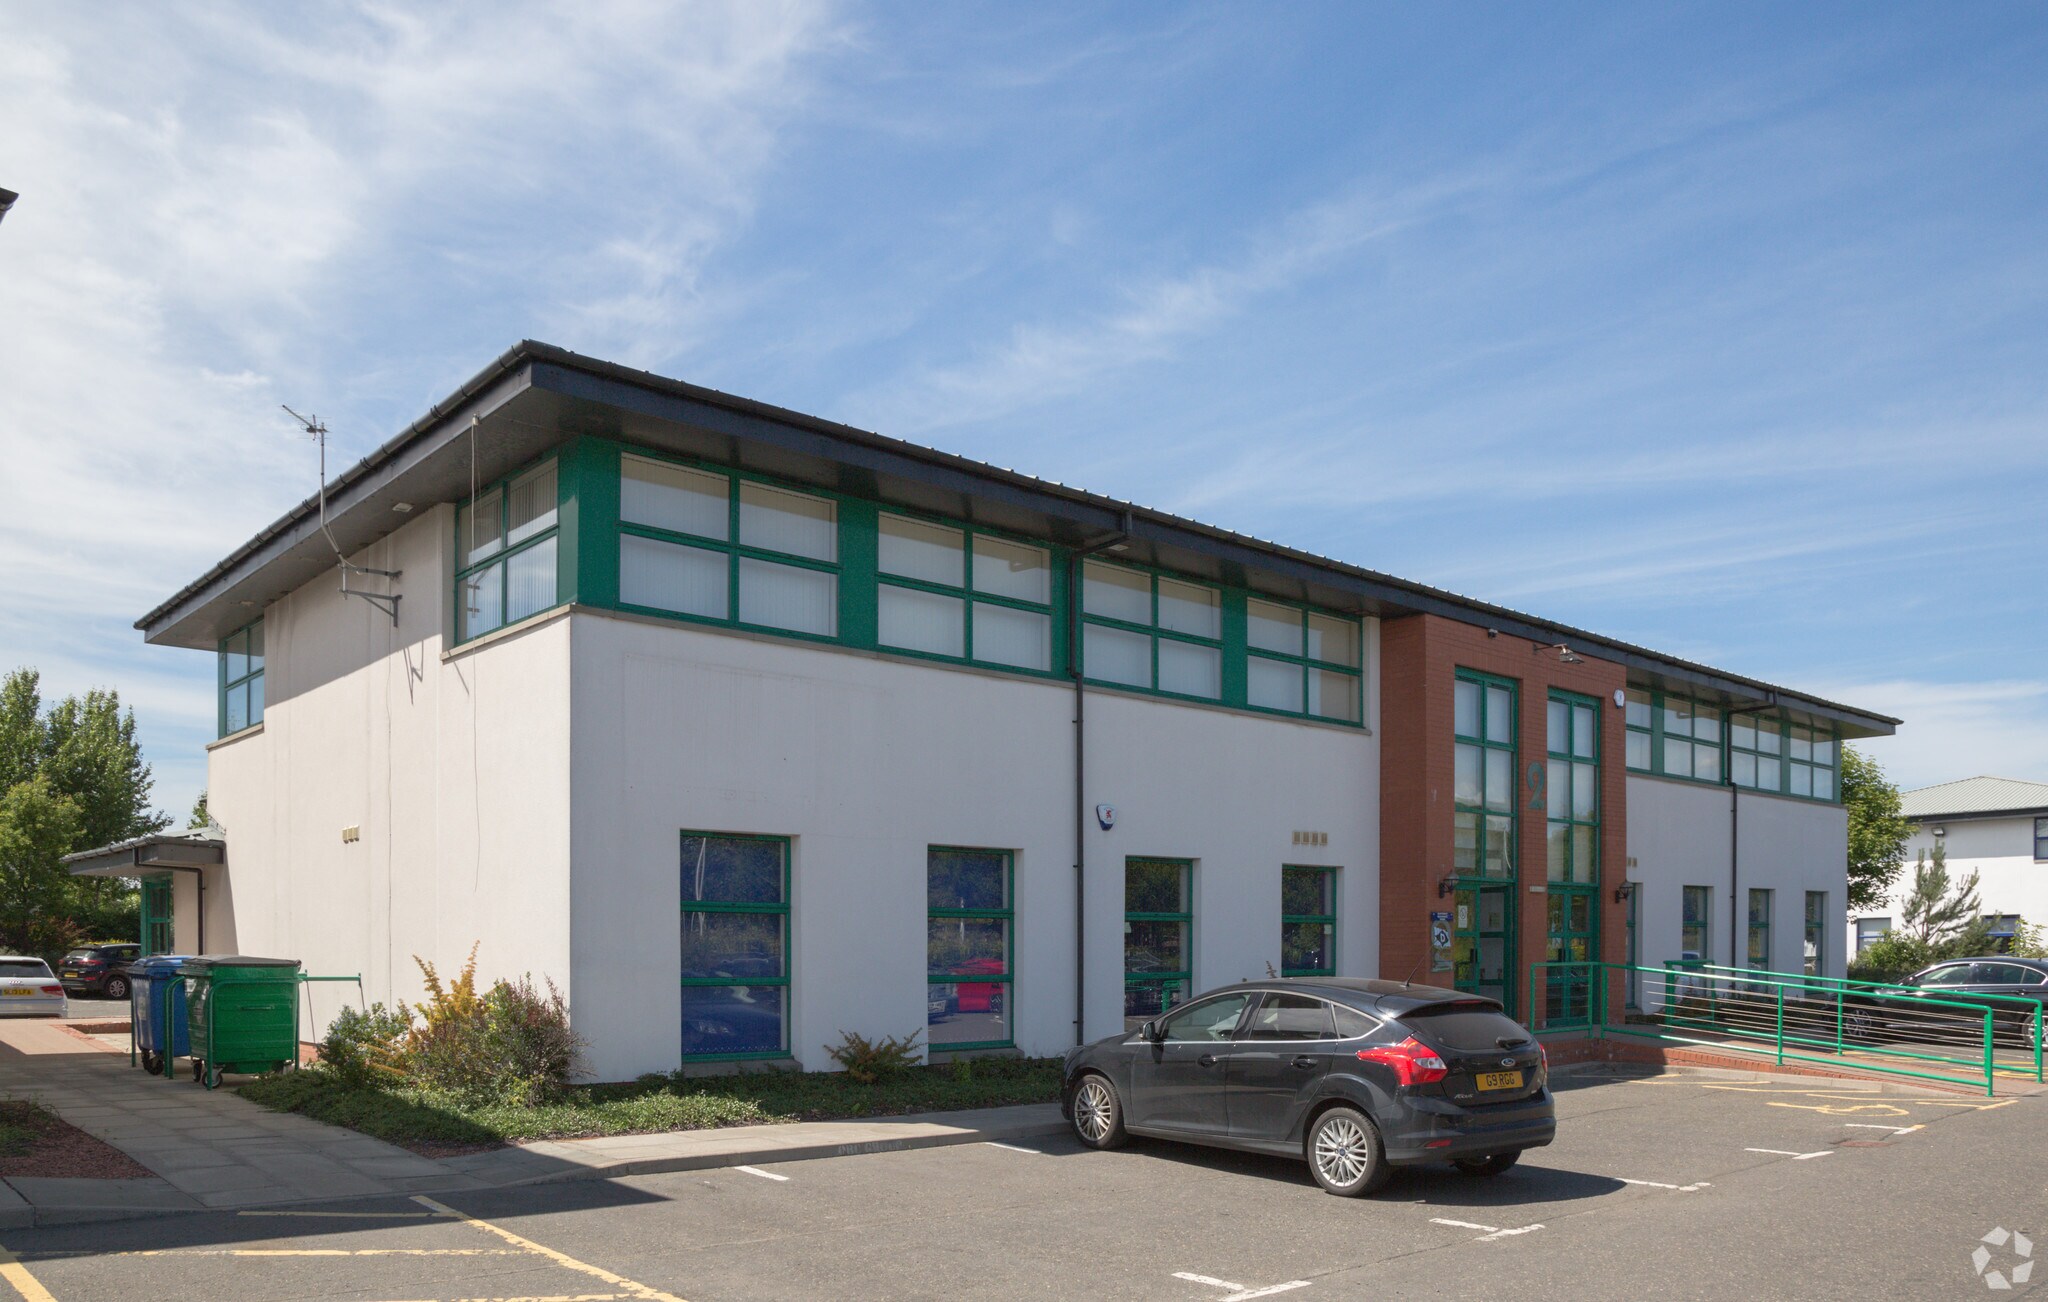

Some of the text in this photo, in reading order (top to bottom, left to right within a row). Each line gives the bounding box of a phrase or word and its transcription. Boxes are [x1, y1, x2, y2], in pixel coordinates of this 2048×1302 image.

[1526, 761, 1545, 810] 2
[1486, 1073, 1515, 1087] G9 RGG
